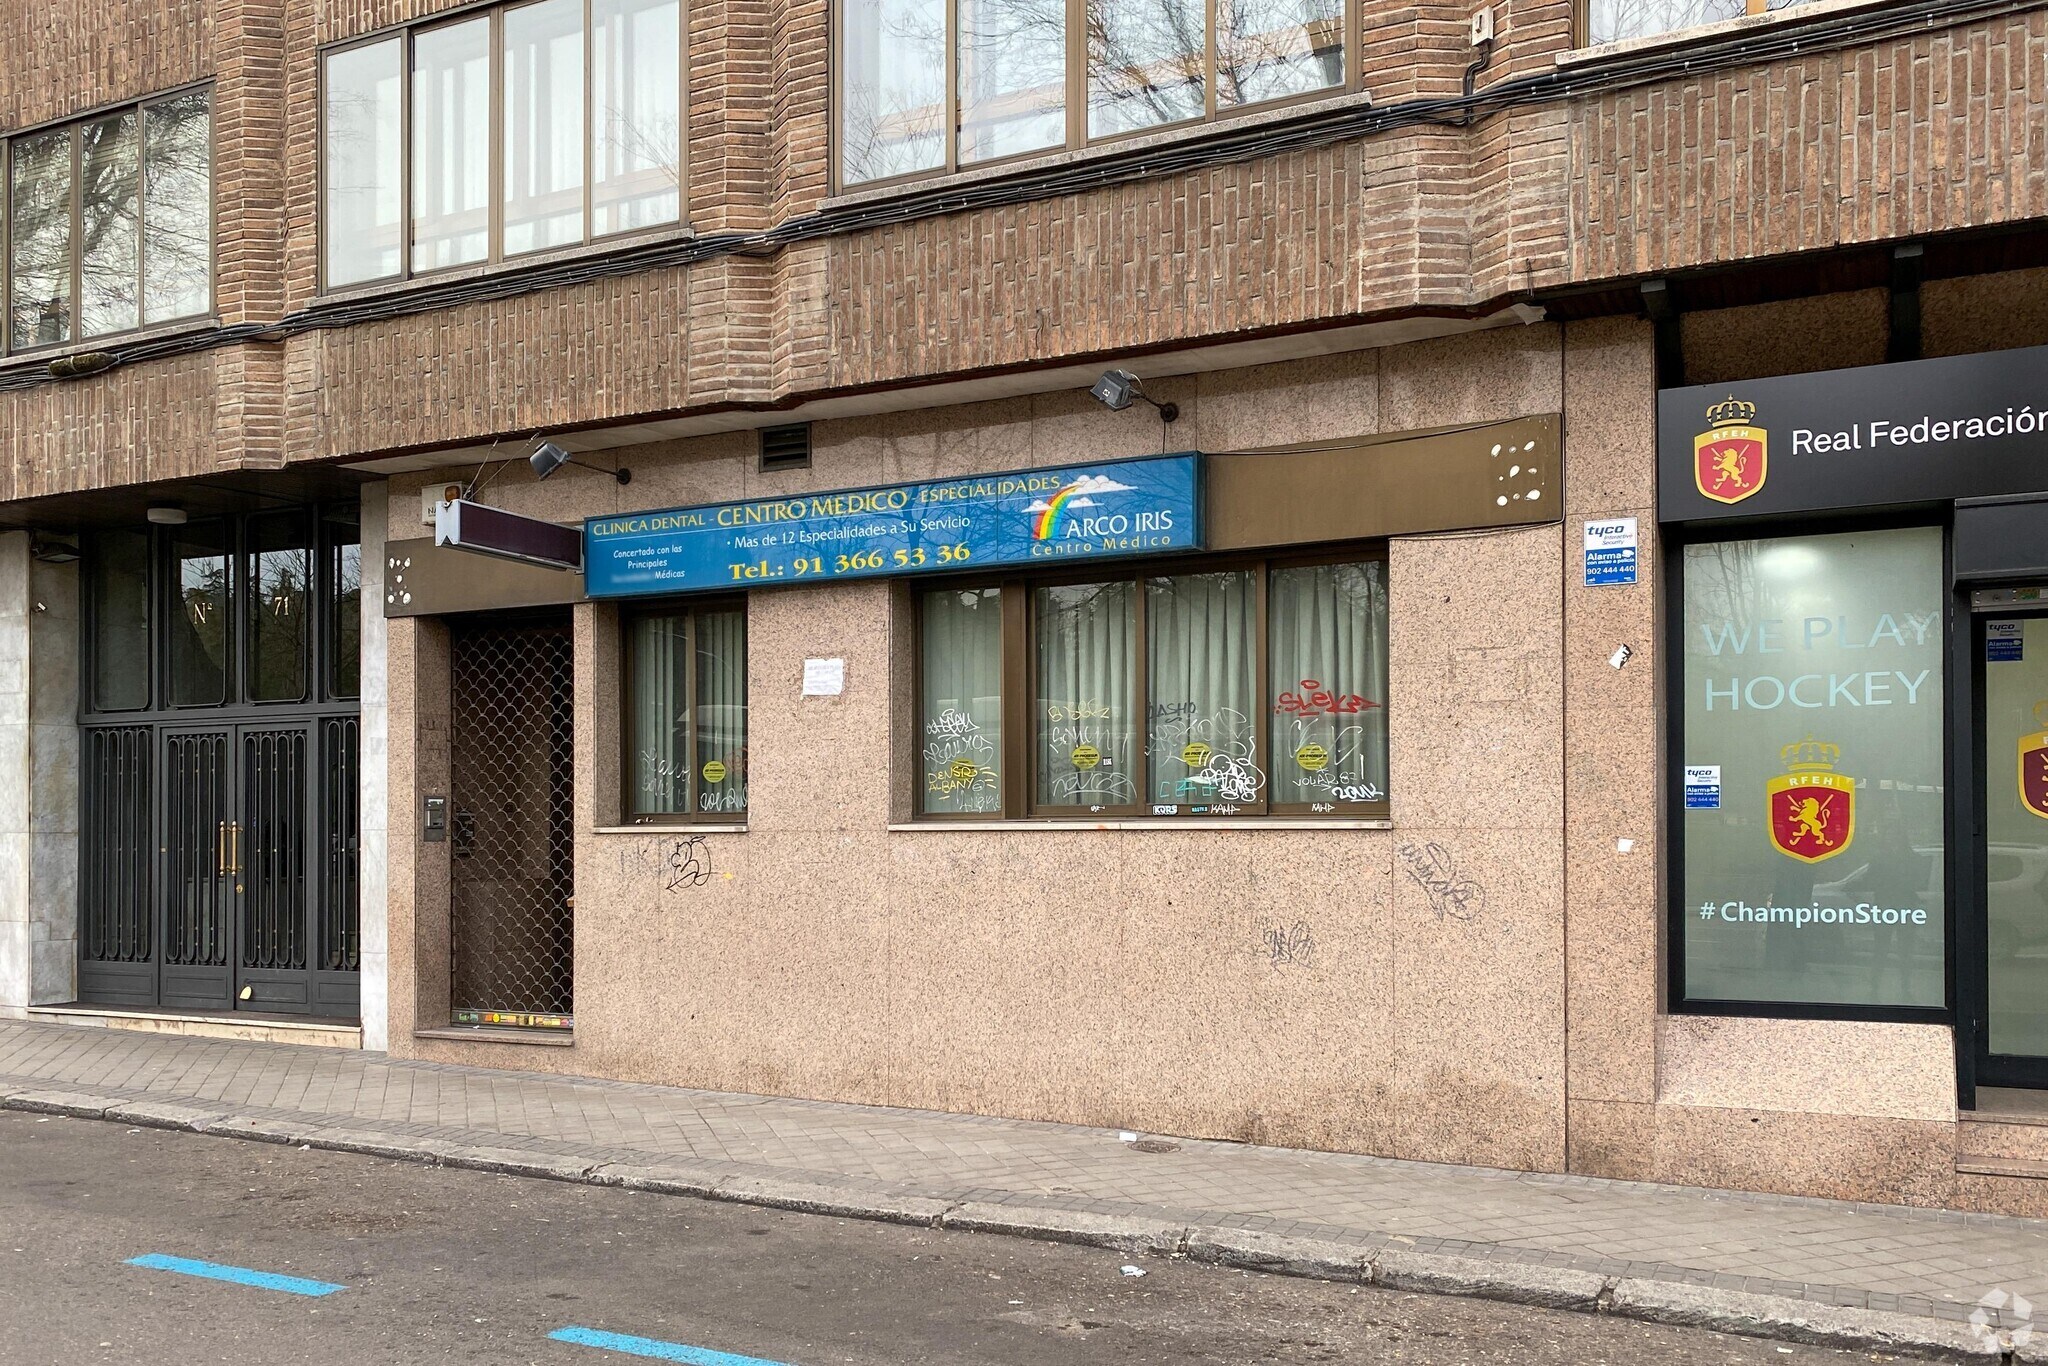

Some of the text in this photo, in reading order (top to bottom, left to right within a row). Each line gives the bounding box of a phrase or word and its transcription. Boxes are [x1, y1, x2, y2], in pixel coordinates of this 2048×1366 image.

[1712, 429, 1750, 441] RFEH
[1792, 424, 1861, 455] Real
[593, 520, 649, 536] CLINICA
[651, 513, 706, 530] DENTAL
[717, 501, 807, 526] CENTRO
[810, 490, 908, 517] MEDICO
[921, 476, 1060, 503] ESPECIALIDADES
[734, 515, 971, 549] Mas de 12 Especialidades a Su Servicio
[1066, 510, 1174, 538] ARCO IRIS
[1587, 525, 1625, 538] tyco
[613, 544, 683, 559] Concertado con las
[1032, 535, 1171, 557] Centro Médico
[627, 558, 668, 570] Principales
[728, 542, 971, 580] Tel.: 91 366 53 36
[1587, 552, 1622, 561] Alarma
[655, 569, 685, 580] Médicas
[1587, 565, 1635, 575] 902 444 440
[274, 596, 290, 616] 71
[1702, 610, 1940, 656] WE PLAY
[1989, 624, 2016, 632] tyco
[1705, 669, 1931, 711] HOCKEY
[1687, 769, 1712, 778] tyco
[1789, 775, 1833, 787] RFEH
[1720, 900, 1928, 929] ChampionStore
